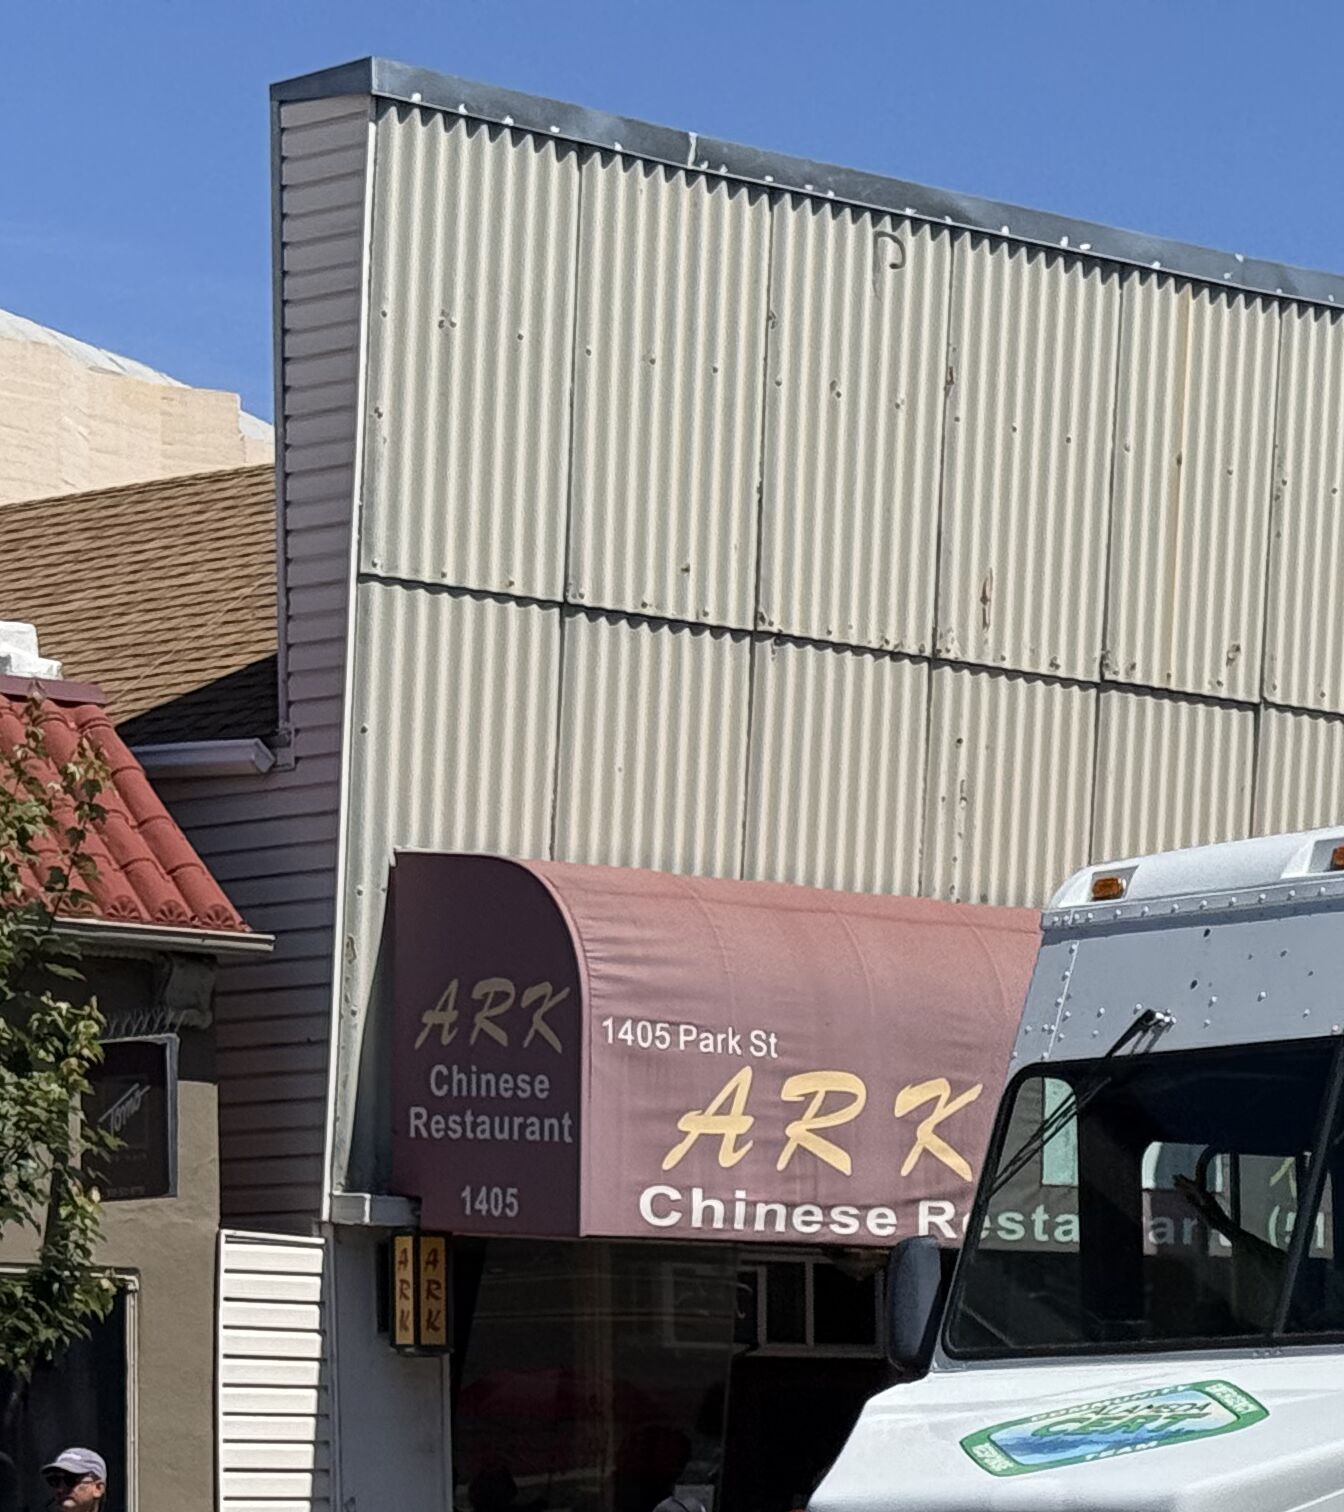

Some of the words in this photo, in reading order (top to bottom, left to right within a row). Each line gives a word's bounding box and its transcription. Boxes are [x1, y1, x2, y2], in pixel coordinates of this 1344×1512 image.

[414, 977, 571, 1054] ARK
[601, 1018, 671, 1050] 1405
[679, 1025, 742, 1057] Park
[749, 1029, 779, 1060] St
[430, 1064, 550, 1100] Chinese
[409, 1106, 573, 1144] Restaurant
[662, 1065, 984, 1183] ARK
[460, 1185, 519, 1218] 1405
[638, 1184, 898, 1236] Chinese
[424, 1247, 443, 1333] ARK
